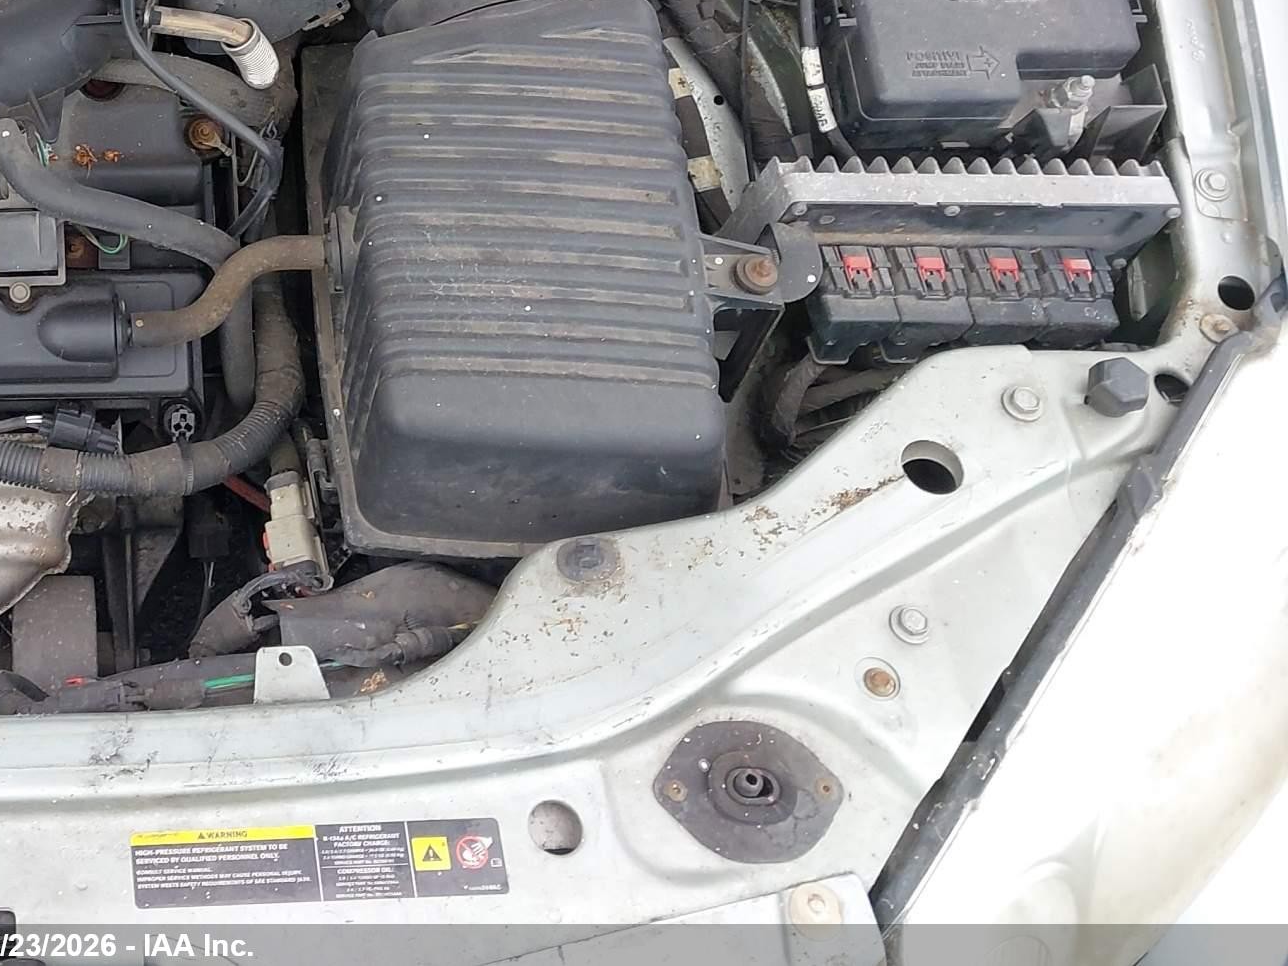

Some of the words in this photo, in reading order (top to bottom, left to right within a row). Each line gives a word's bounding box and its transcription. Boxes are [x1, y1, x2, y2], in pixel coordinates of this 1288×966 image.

[339, 824, 382, 833] ATTENTION
[206, 830, 249, 840] WARNING
[240, 844, 268, 852] SYSTEM
